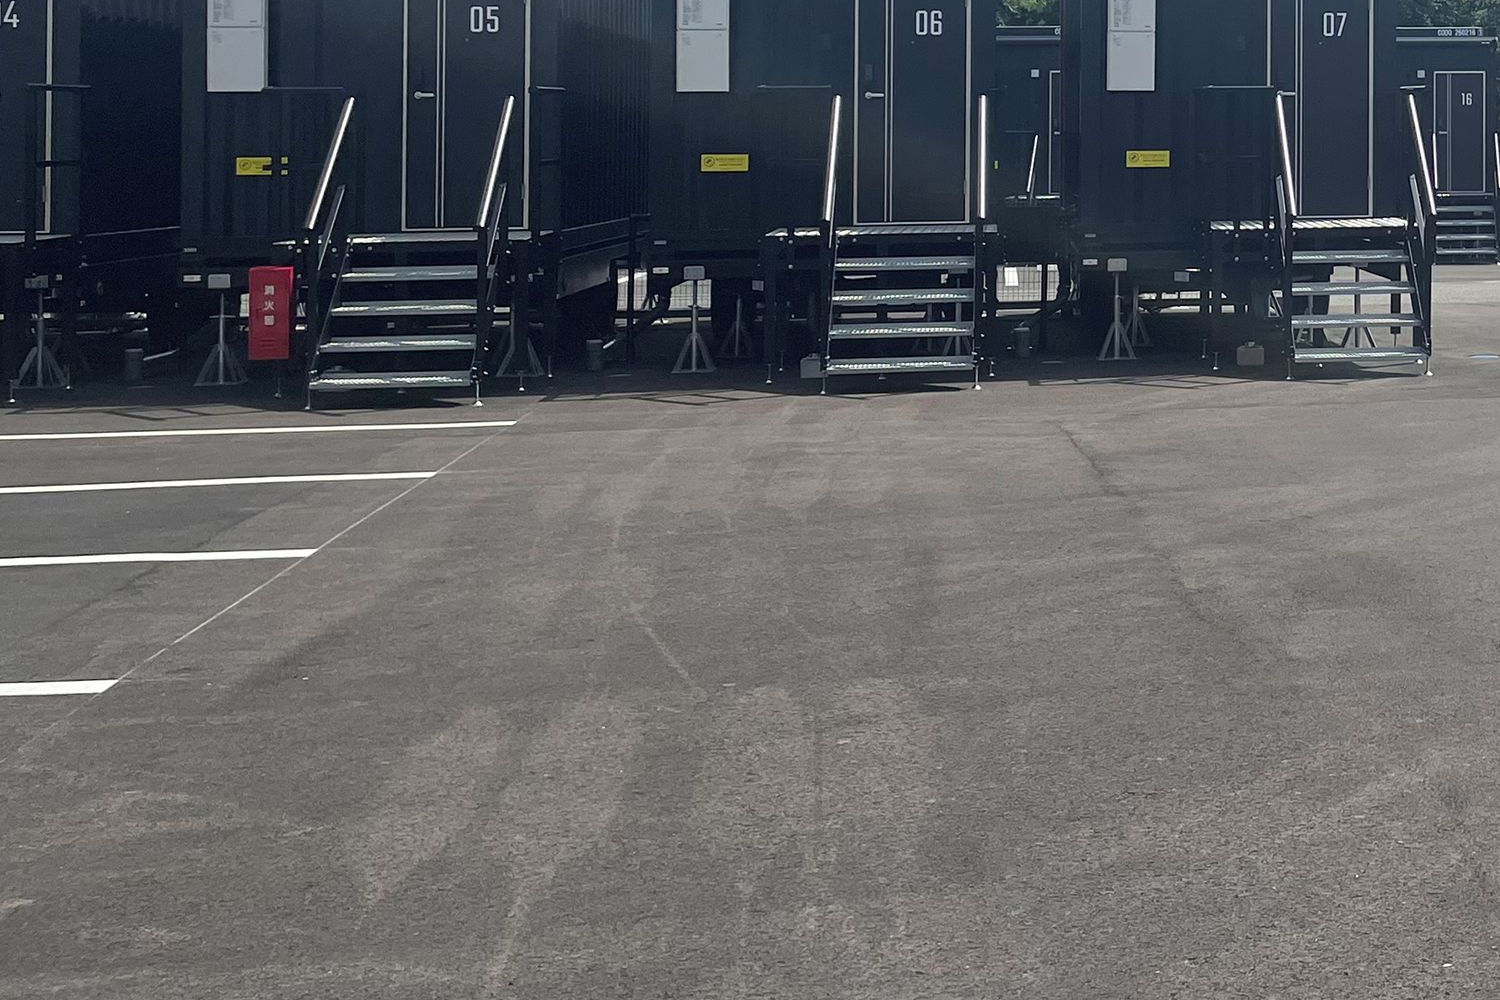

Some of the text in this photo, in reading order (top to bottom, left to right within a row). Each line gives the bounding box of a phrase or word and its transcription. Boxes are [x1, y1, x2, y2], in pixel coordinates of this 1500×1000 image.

[0, 1, 20, 28] 4
[470, 6, 499, 33] 05
[916, 10, 943, 35] 06
[1323, 12, 1347, 37] 07
[1461, 92, 1473, 106] 16
